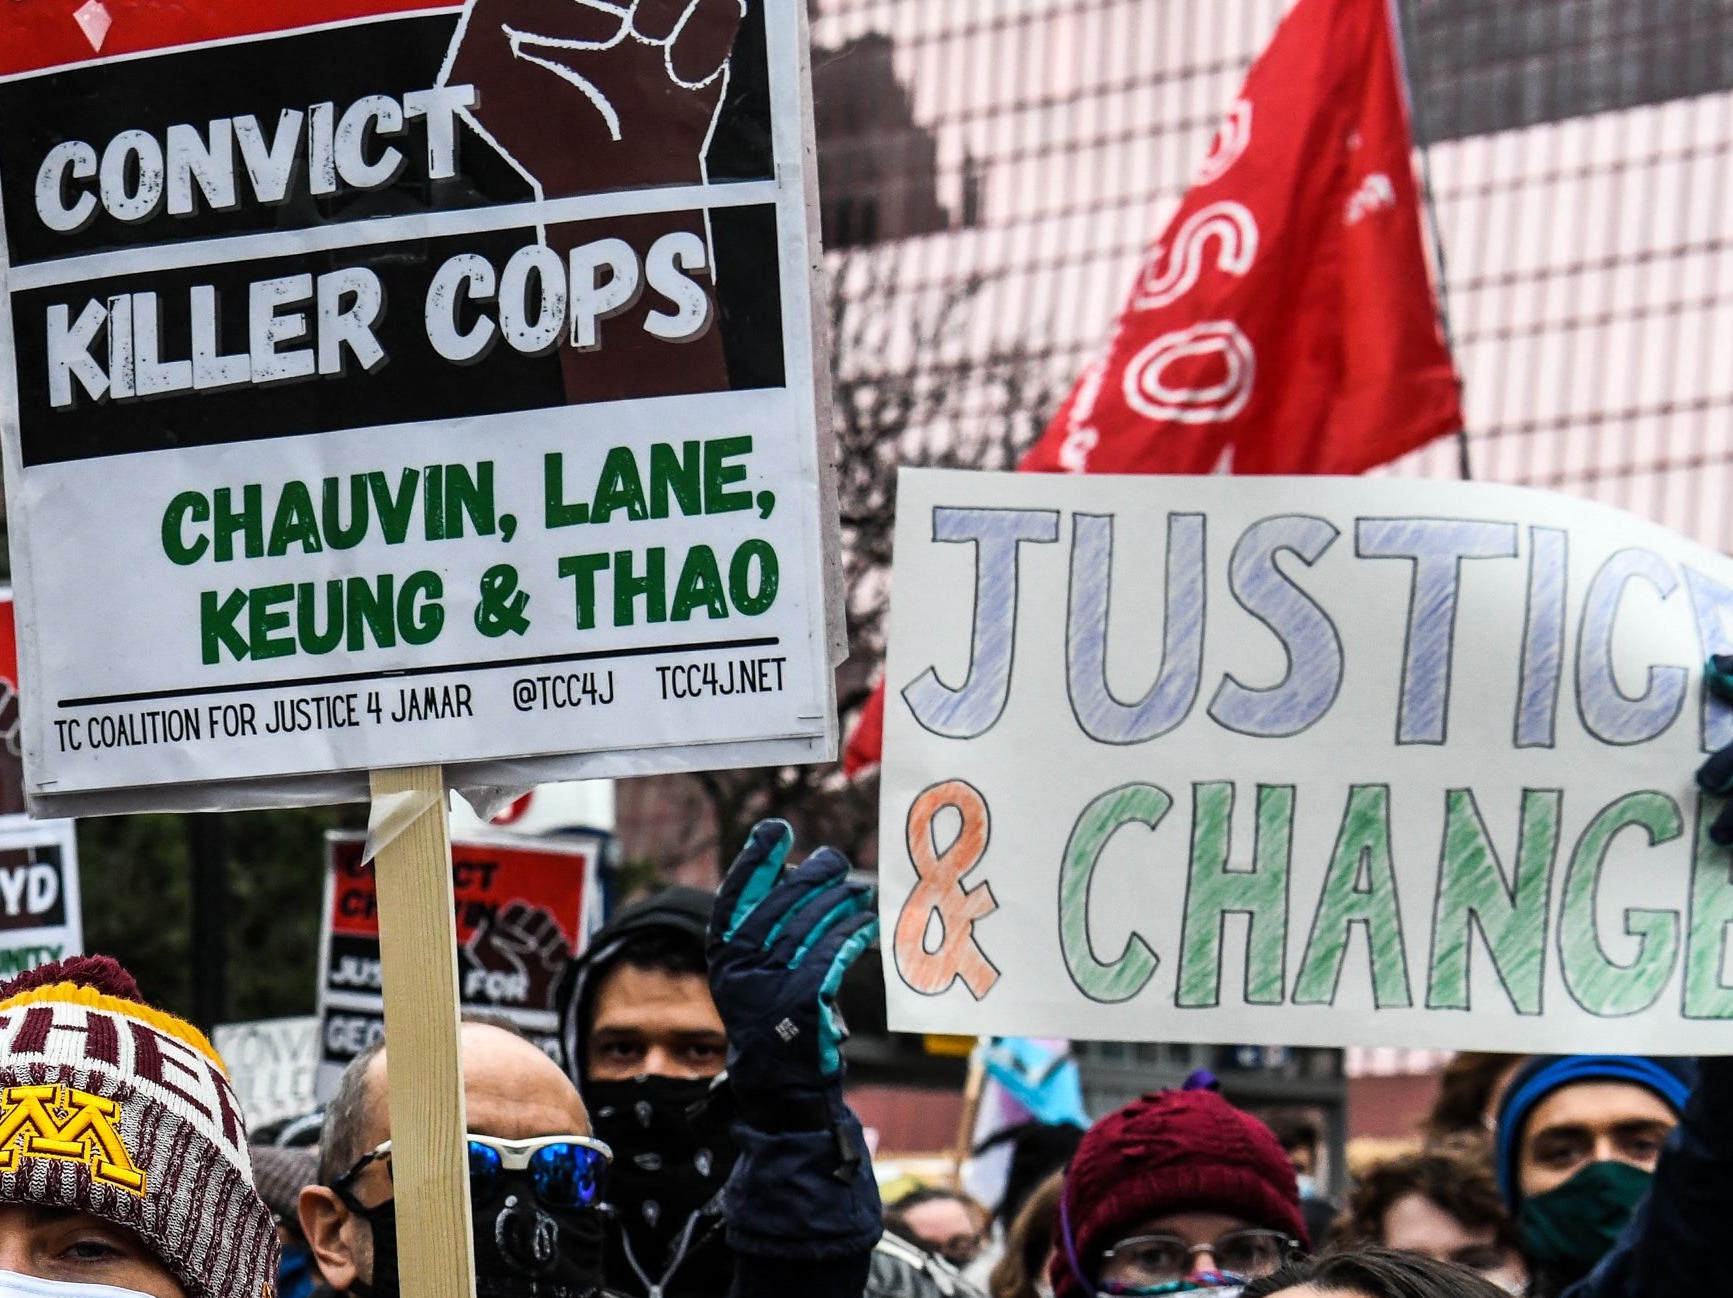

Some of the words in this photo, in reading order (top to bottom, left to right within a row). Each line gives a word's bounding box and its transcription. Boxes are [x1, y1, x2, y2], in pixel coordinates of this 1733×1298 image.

[34, 84, 480, 232] CONVICT
[45, 266, 387, 410] KILLER
[424, 231, 714, 362] COPS
[161, 460, 517, 567] CHAUVIN,
[542, 433, 776, 526] LANE,
[200, 569, 445, 665] KEUNG
[473, 563, 530, 639] &
[558, 538, 781, 631] THAO
[54, 718, 82, 752] TC
[88, 709, 200, 748] COALITION
[208, 704, 256, 737] FOR
[265, 694, 359, 733] JUSTICE
[367, 693, 381, 722] 4
[391, 684, 473, 722] JAMAR
[512, 671, 614, 713] @TCC4J
[656, 657, 787, 701] TCC4J.NET
[893, 777, 1002, 1001] &
[464, 970, 528, 1001] FOR
